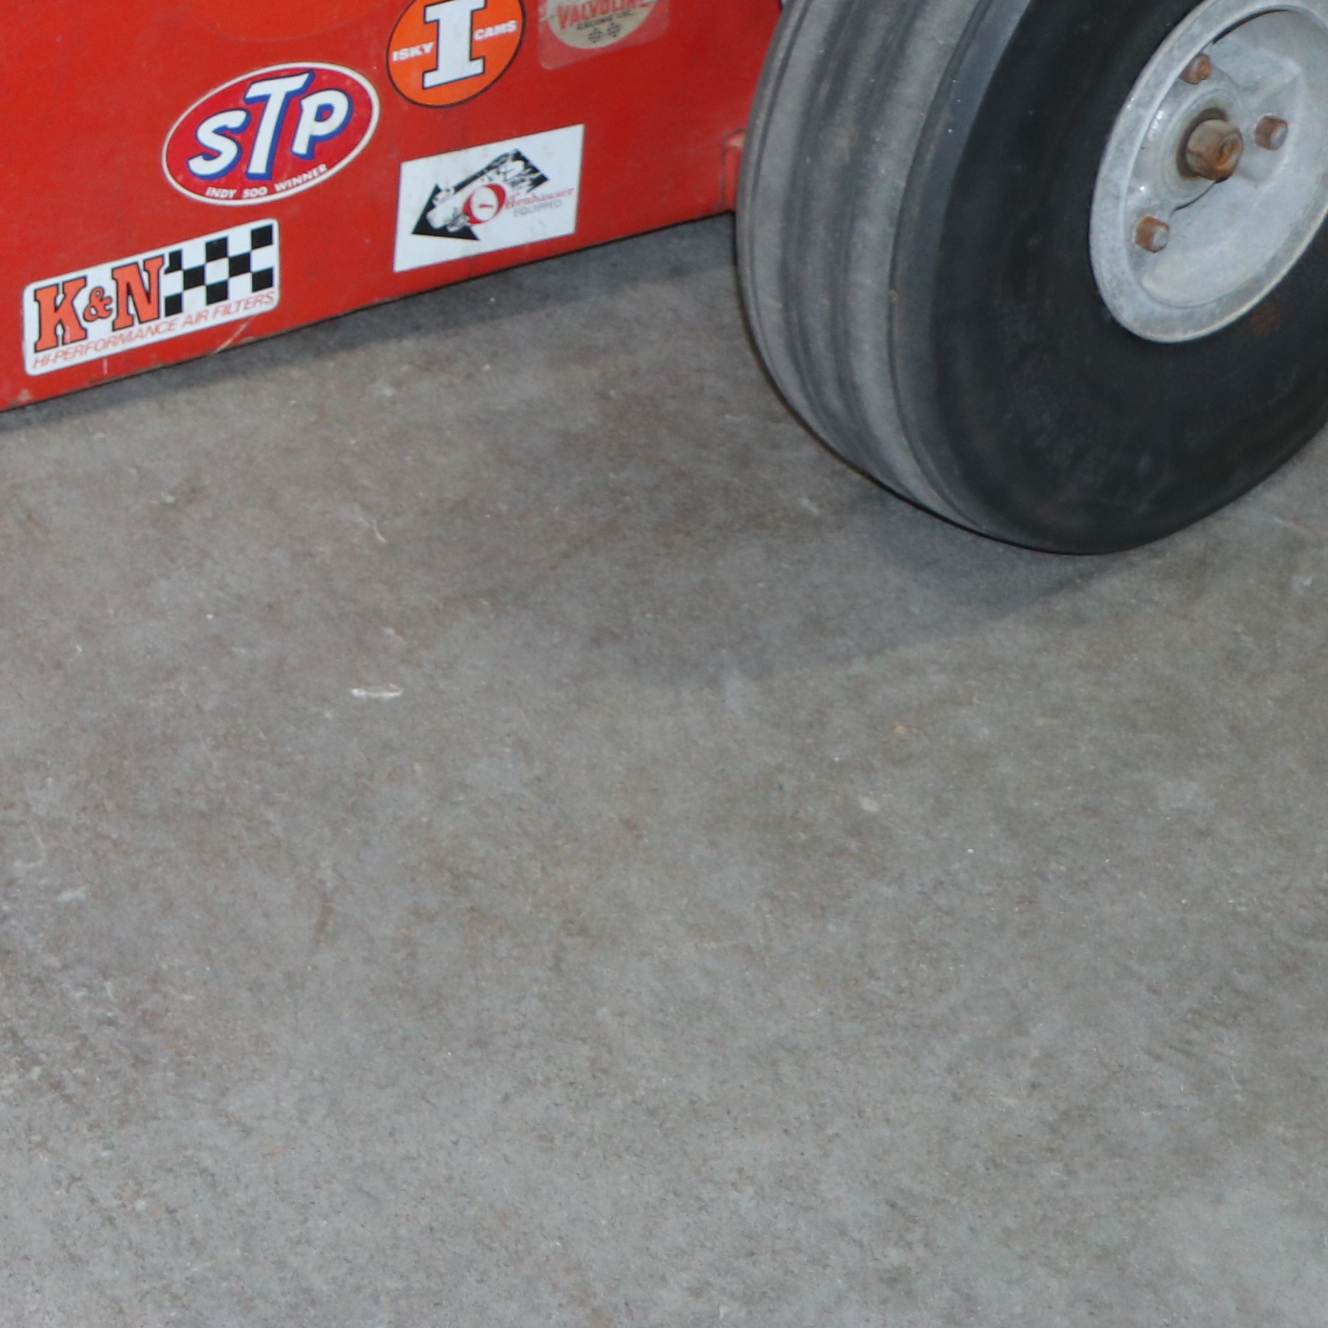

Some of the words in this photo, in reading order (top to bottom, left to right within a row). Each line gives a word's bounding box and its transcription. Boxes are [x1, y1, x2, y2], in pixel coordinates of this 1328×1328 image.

[392, 41, 435, 62] ISKY
[473, 19, 518, 41] CAMS
[187, 69, 354, 181] STP
[204, 186, 237, 199] INDY
[274, 163, 328, 193] WINNER
[34, 253, 166, 353] K&N
[182, 309, 210, 328] AIR
[212, 290, 275, 319] FILTERS
